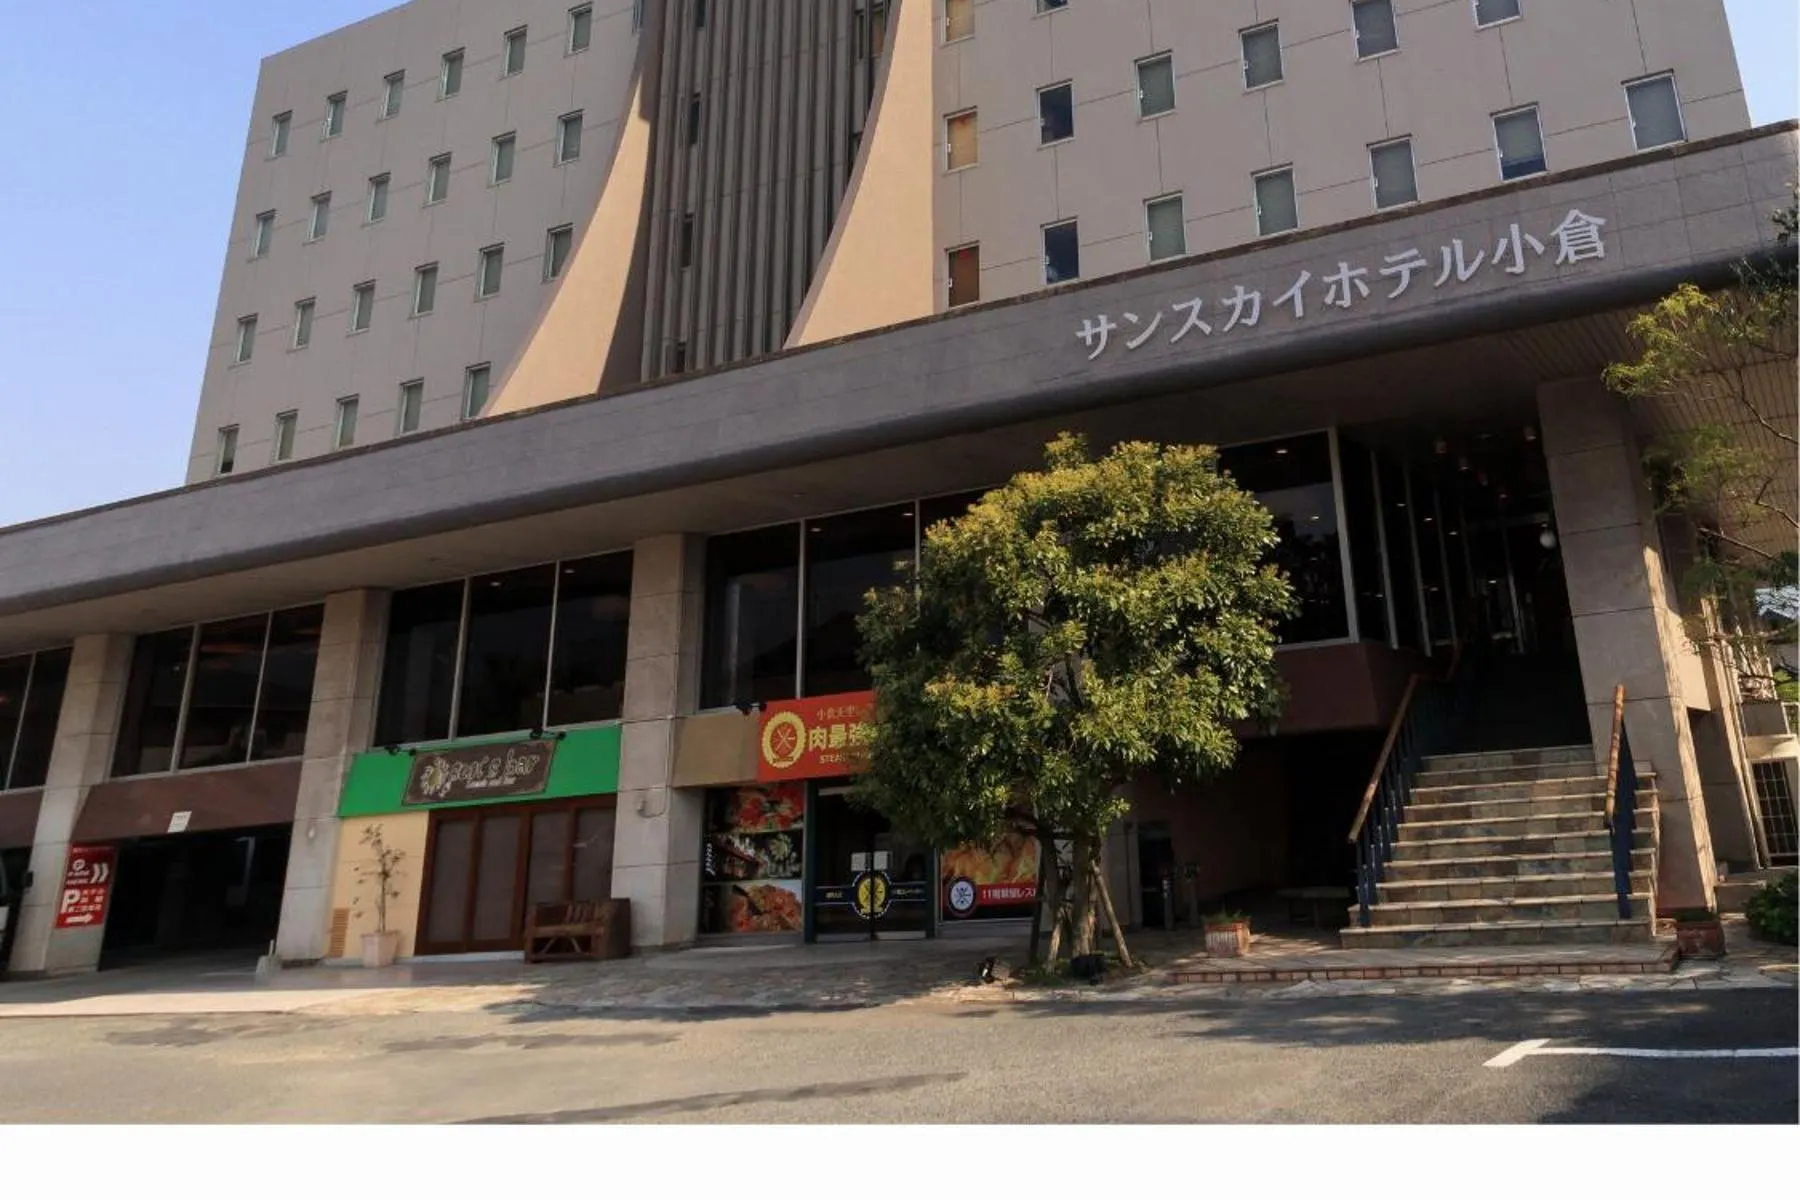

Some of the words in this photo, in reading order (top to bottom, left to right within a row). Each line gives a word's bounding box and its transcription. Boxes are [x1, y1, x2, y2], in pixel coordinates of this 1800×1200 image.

[1075, 209, 1608, 360] サンスカイホテル小倉
[60, 889, 80, 913] P
